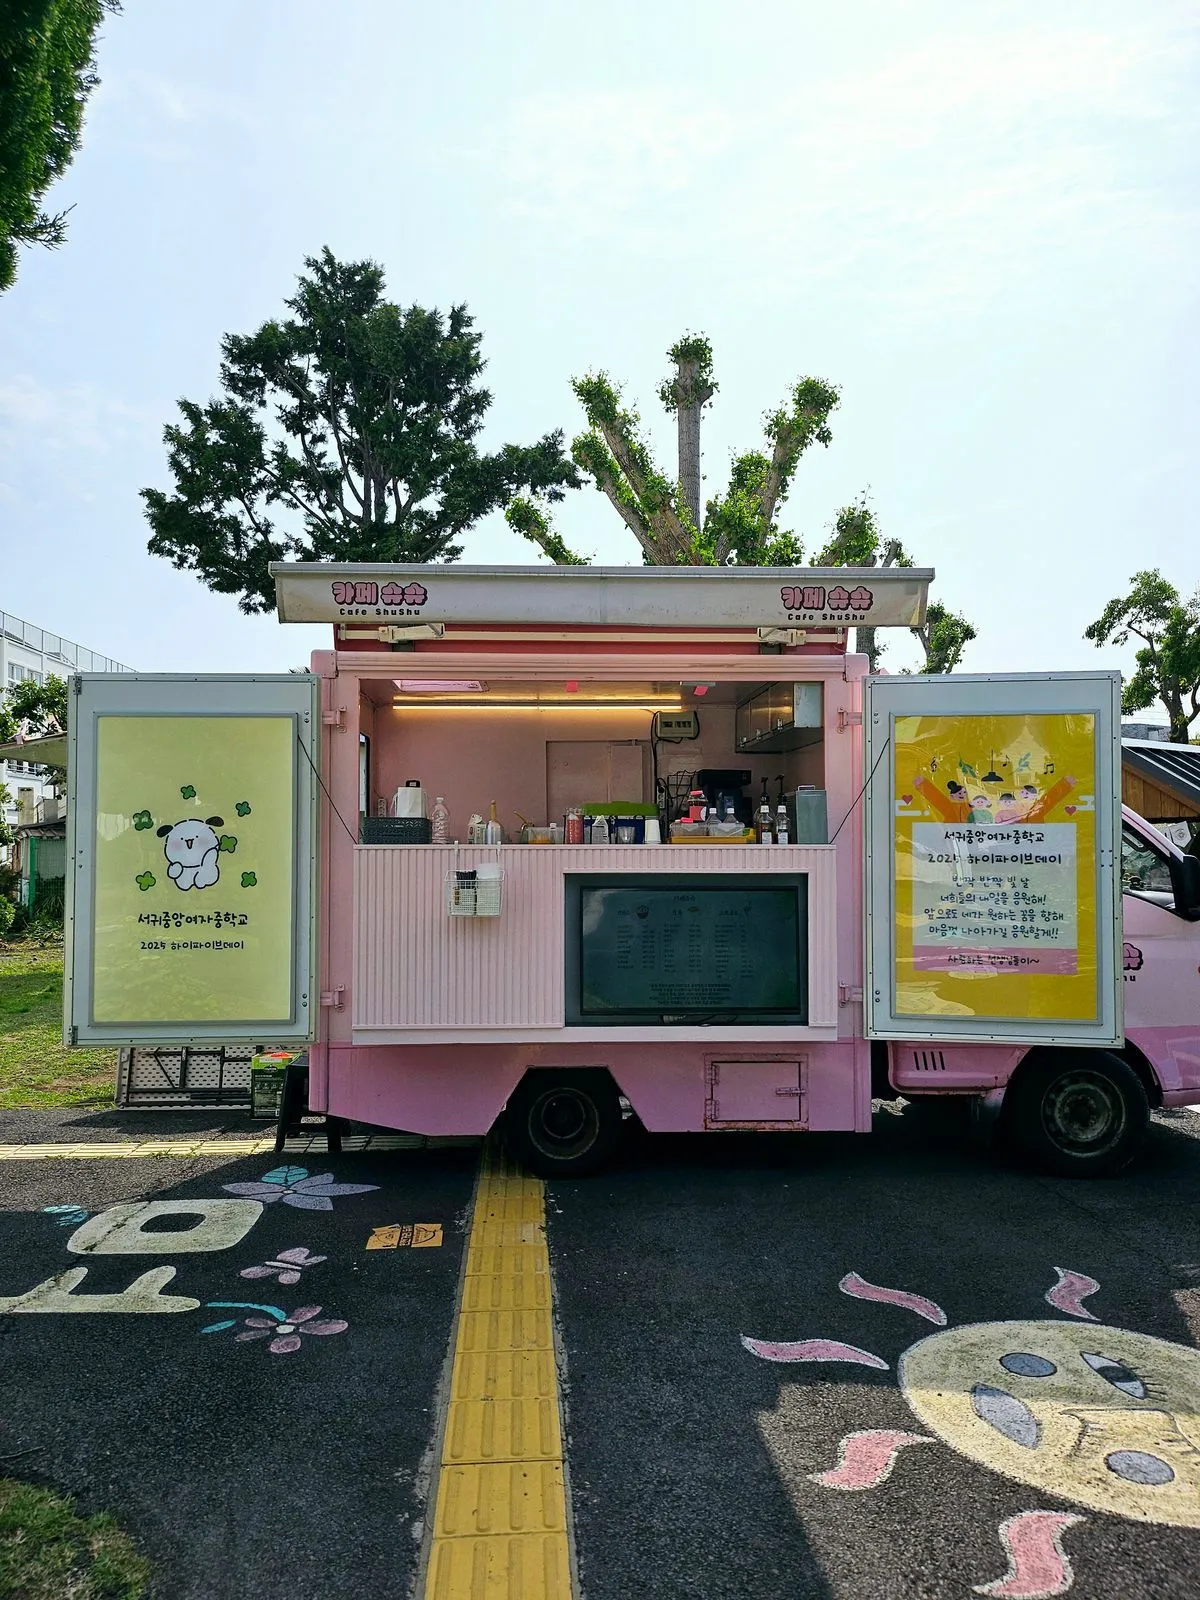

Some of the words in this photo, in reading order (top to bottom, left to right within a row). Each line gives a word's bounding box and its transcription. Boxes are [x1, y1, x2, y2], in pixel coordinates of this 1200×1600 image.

[332, 582, 378, 605] 카페
[380, 582, 427, 606] 슈슈
[781, 586, 826, 610] 카페
[827, 586, 873, 610] 슈슈
[340, 608, 367, 616] Cafe
[376, 608, 420, 616] ShuShu
[944, 829, 1045, 845] 서귀중앙여자중학교
[928, 853, 960, 864] 2025
[966, 853, 1062, 865] 하이파이브데이
[952, 875, 975, 889] 반짝
[979, 875, 1003, 889] 반짝
[940, 892, 976, 905] 너희들의
[979, 892, 1009, 905] 내일을
[1013, 892, 1047, 906] 응원해!
[138, 911, 248, 928] 서귀중앙여자중학교
[924, 908, 958, 921] 앞으로도
[962, 910, 984, 921] 네가
[987, 908, 1017, 921] 원하는
[1020, 909, 1036, 922] 꿈을
[1040, 909, 1064, 922] 향해
[928, 923, 958, 937] 마음껏
[962, 927, 1007, 938] 나아가길
[1011, 924, 1059, 940] 응원할게!!
[140, 941, 166, 950] 2025
[170, 940, 244, 950] 하이파이브데이
